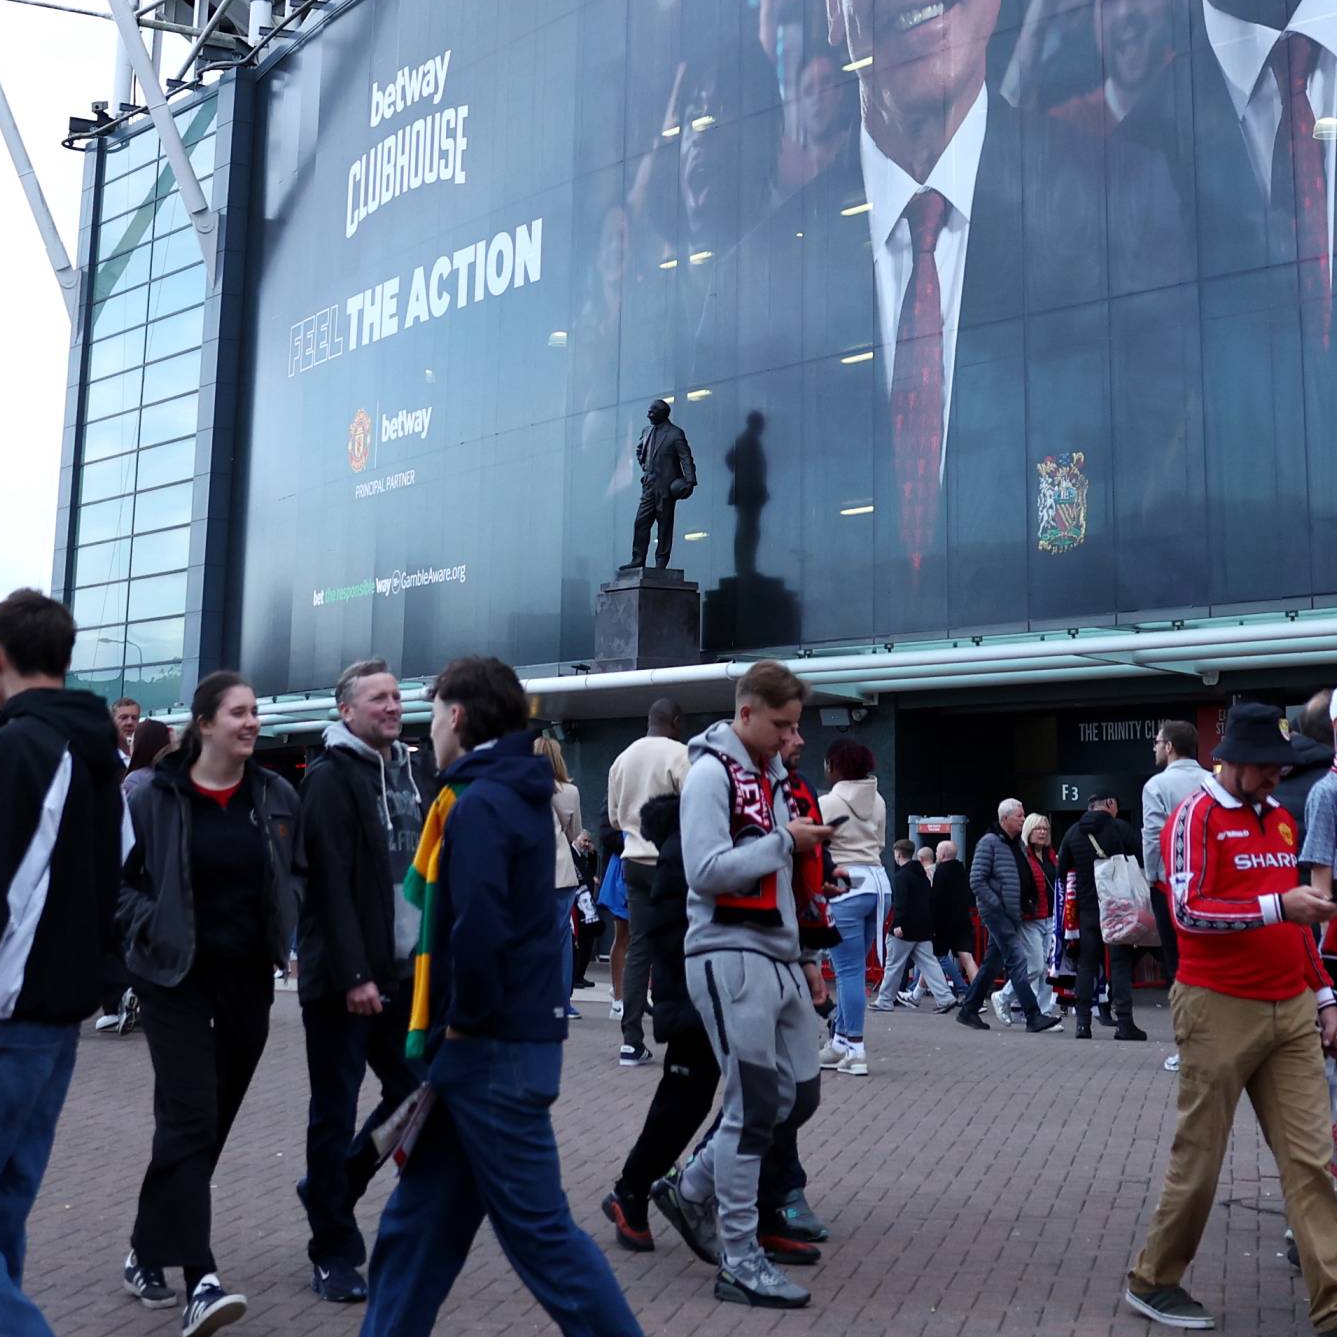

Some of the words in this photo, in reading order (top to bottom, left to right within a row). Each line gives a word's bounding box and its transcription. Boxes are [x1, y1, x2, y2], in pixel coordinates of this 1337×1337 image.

[370, 49, 452, 128] betway
[345, 104, 469, 239] CLUBHOUSE
[287, 304, 344, 378] FEEL
[346, 276, 401, 352] THE
[404, 217, 543, 330] ACTION
[381, 406, 433, 443] betway
[355, 478, 385, 500] PRINCIPAL
[386, 469, 416, 491] PARTNER
[312, 589, 324, 607] bet
[376, 576, 392, 597] way
[401, 564, 466, 590] GambleAware.org
[1079, 722, 1099, 742] THE
[1101, 720, 1142, 741] TRINITY
[1233, 851, 1298, 871] SHARP
